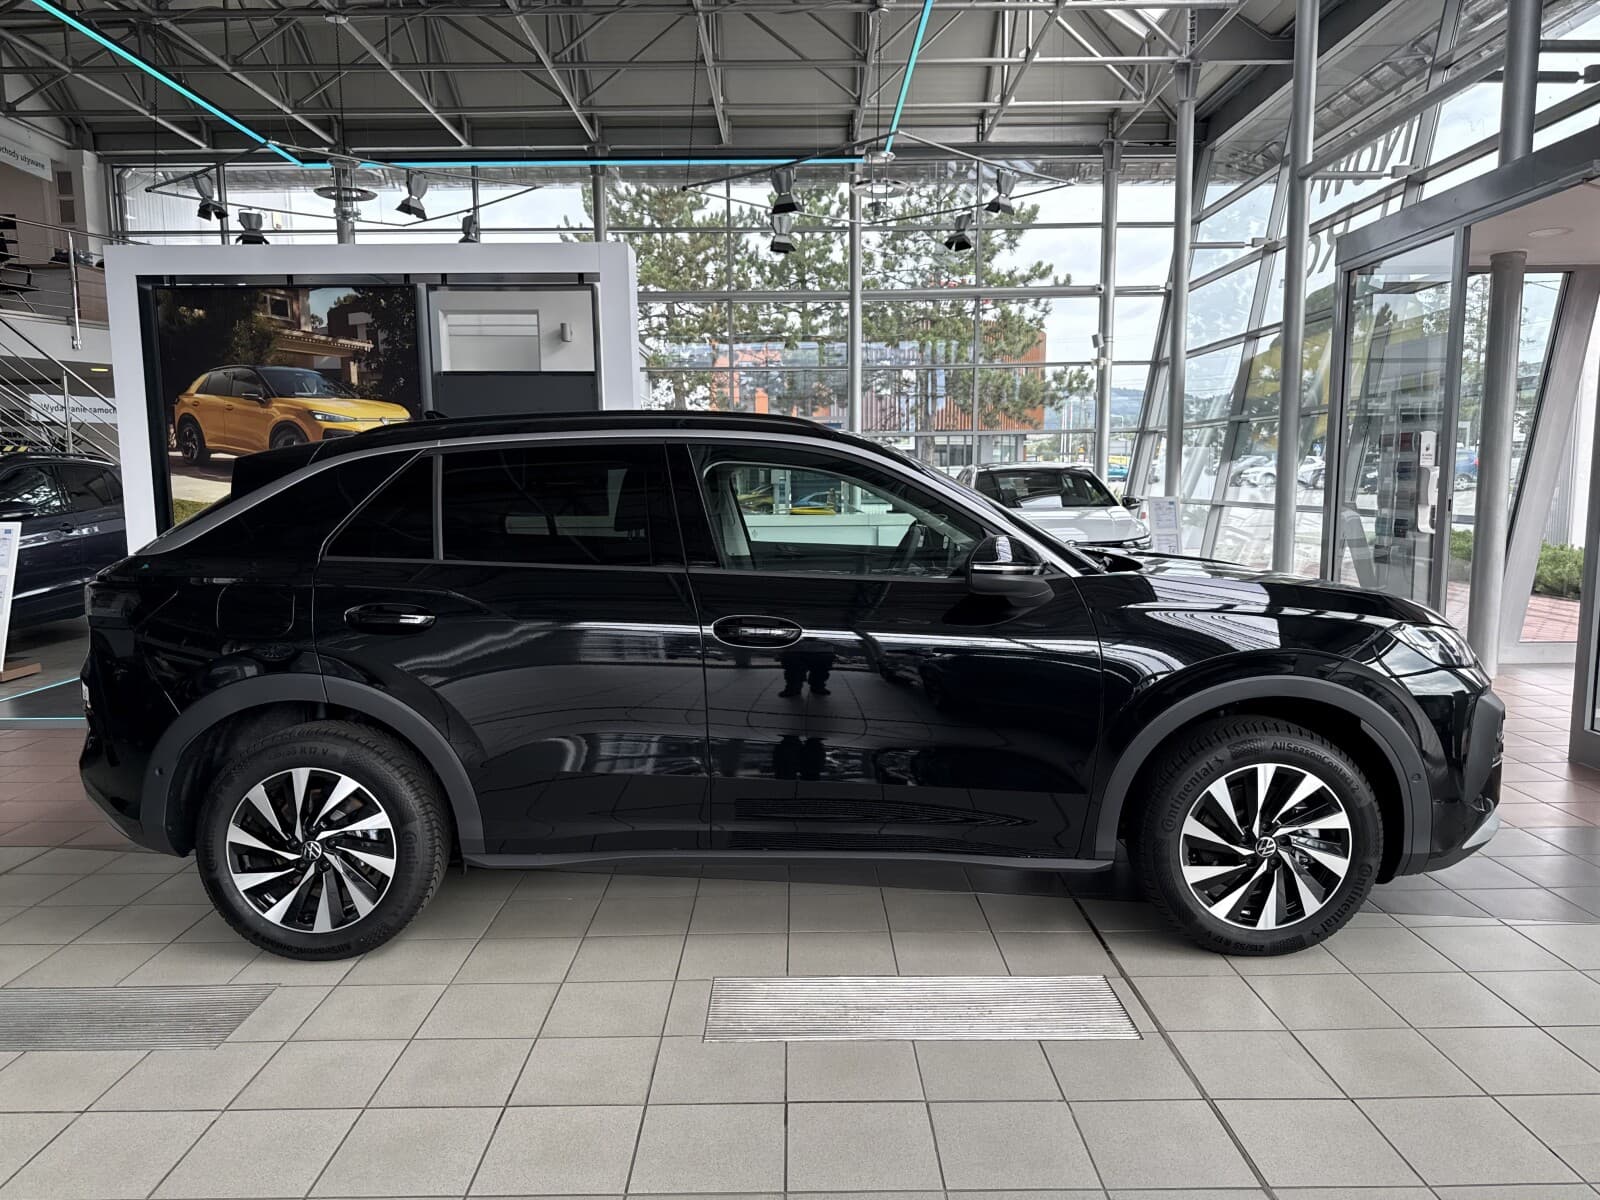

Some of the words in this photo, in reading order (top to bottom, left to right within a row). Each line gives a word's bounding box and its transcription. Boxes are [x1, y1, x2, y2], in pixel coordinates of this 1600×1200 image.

[0, 144, 19, 160] chody
[1161, 761, 1215, 832] Continental
[1320, 863, 1373, 933] Continental
